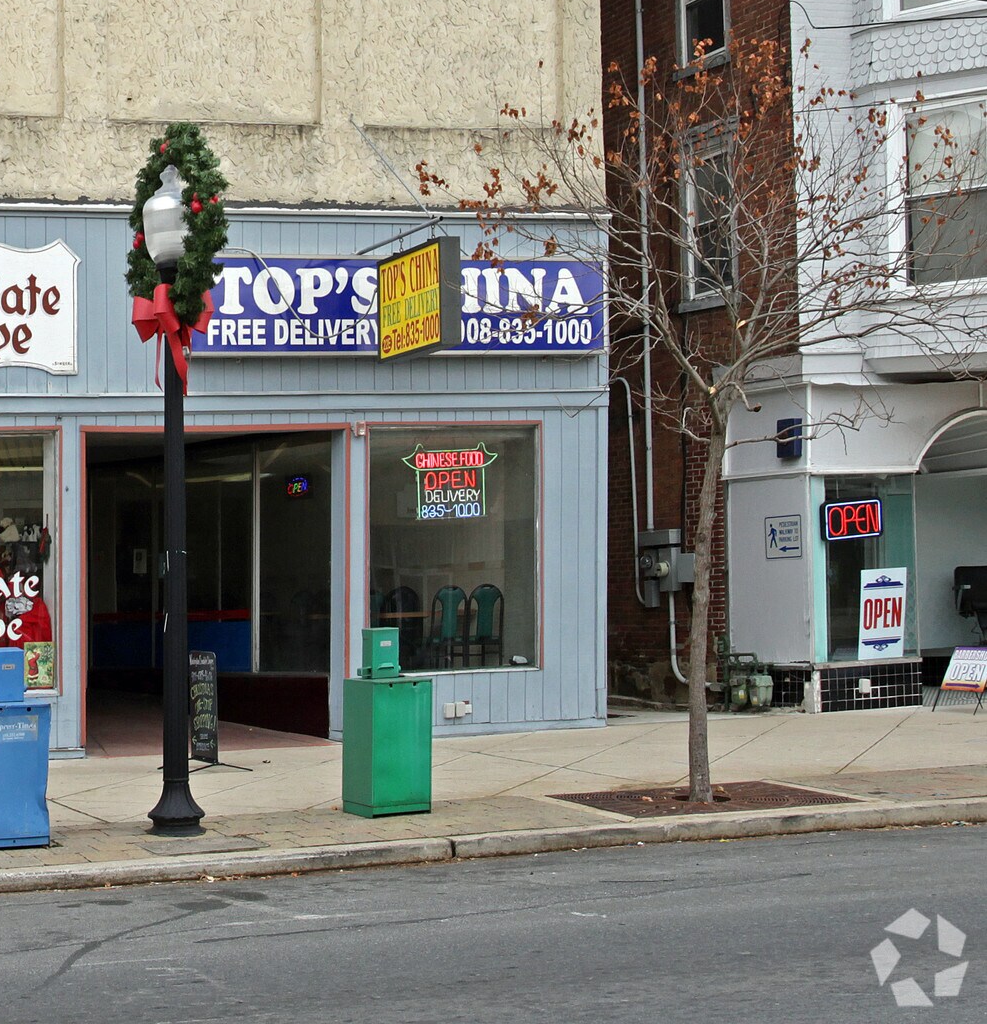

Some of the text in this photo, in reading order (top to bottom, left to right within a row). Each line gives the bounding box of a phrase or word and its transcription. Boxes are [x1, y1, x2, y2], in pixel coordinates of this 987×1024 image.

[381, 249, 439, 303] TOP'S CHINA
[213, 266, 378, 315] TOP'S
[382, 287, 439, 328] FREE DELIVERY
[207, 318, 592, 346] FREE DELIVERY 08-835-1000
[415, 451, 484, 468] CHINESE FOOD
[287, 482, 308, 495] OPEN
[424, 470, 477, 490] OPEN
[424, 488, 481, 504] DELIVERY
[421, 502, 481, 519] 835-1000
[827, 504, 880, 537] OPEN
[863, 596, 903, 631] OPEN
[950, 662, 986, 683] OPEN
